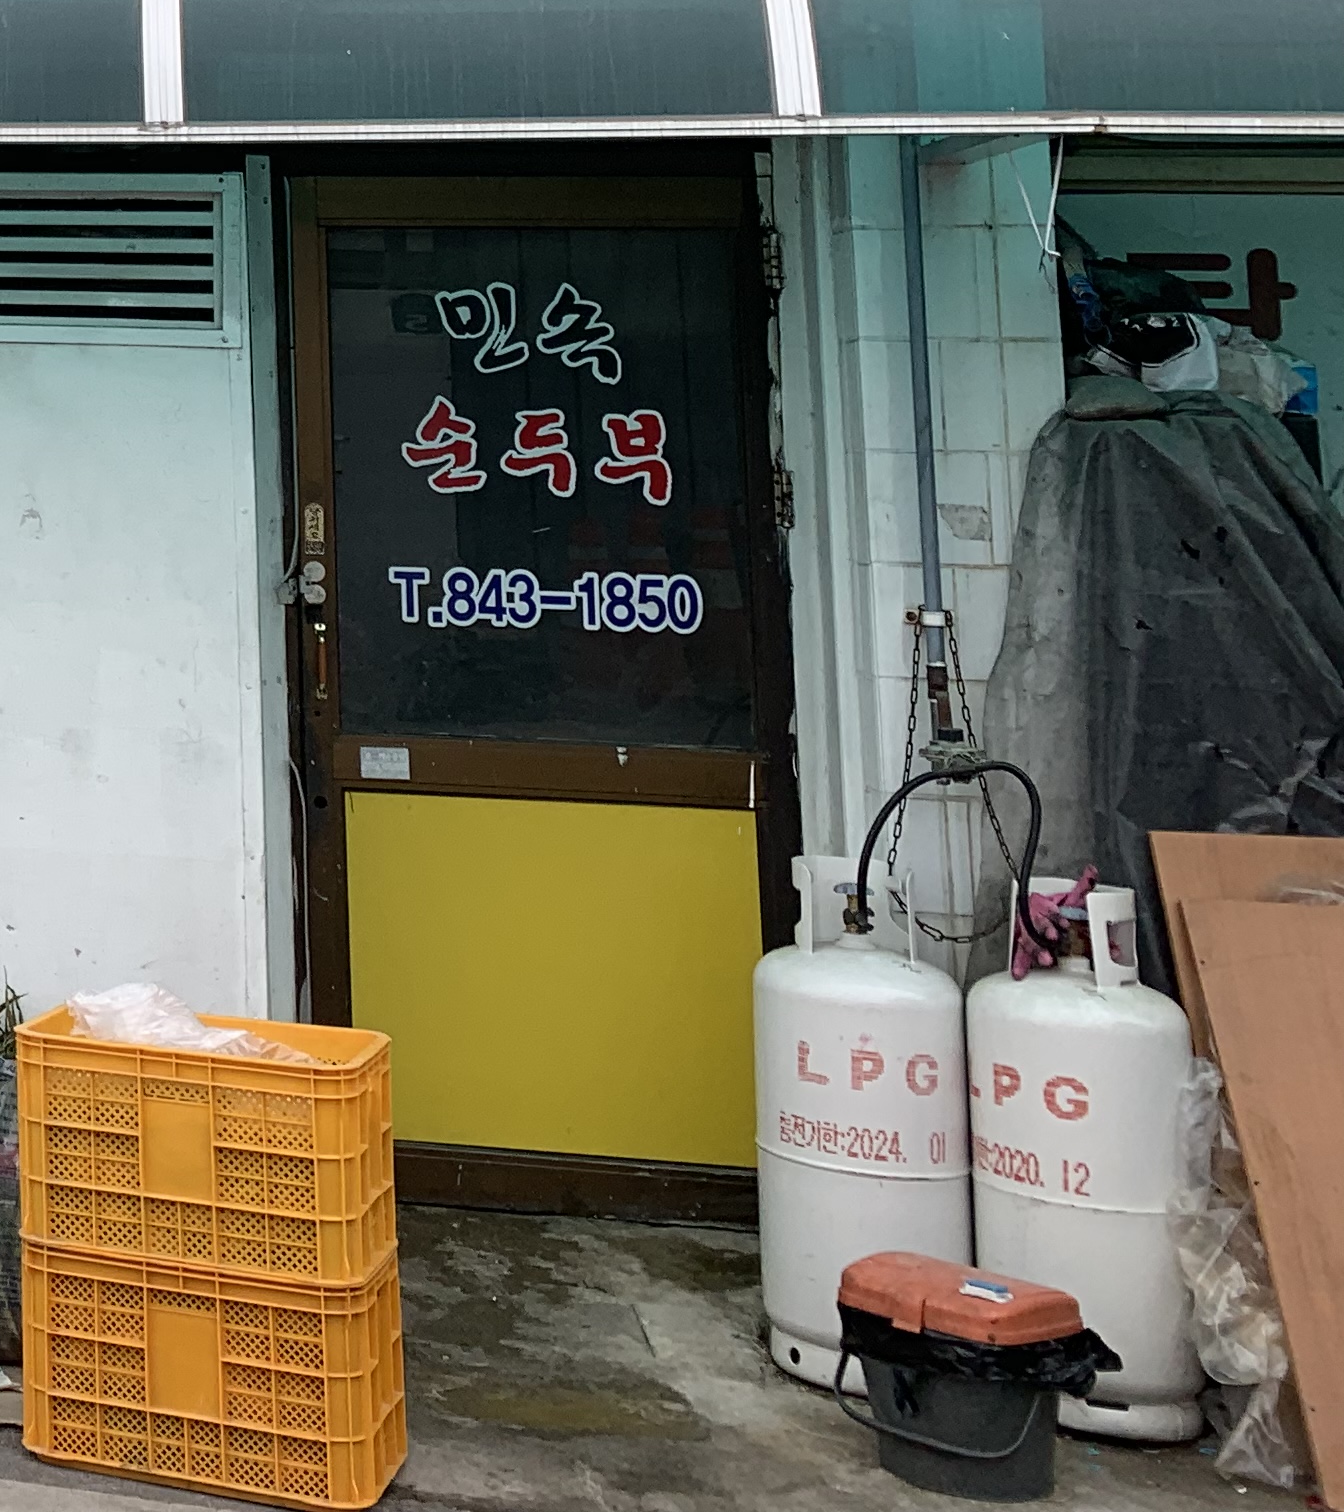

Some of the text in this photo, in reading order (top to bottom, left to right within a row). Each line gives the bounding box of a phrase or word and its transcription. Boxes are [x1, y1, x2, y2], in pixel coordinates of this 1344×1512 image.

[433, 281, 622, 386] 민속
[401, 395, 673, 506] 순두부
[389, 566, 704, 635] T.843-1850
[797, 1040, 939, 1096] LPG
[970, 1062, 1089, 1121] PG
[1063, 1159, 1091, 1197] 12
